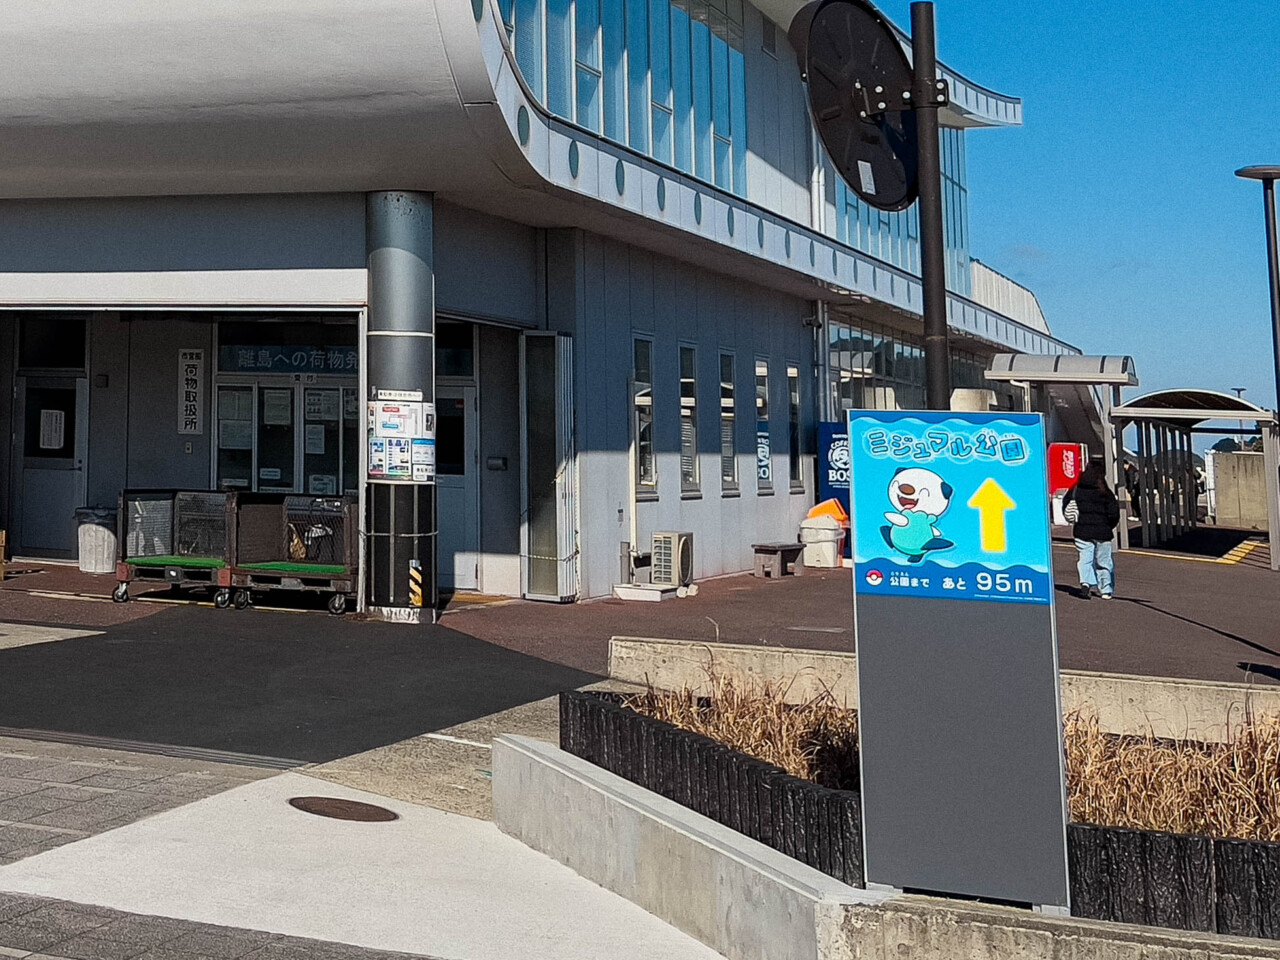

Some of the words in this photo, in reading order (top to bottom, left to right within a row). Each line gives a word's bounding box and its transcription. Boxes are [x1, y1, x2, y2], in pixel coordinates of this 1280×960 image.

[183, 363, 198, 431] 荷物取扱所
[869, 430, 1026, 462] ミジュマル公園
[890, 576, 930, 588] 公園まで
[942, 577, 968, 590] あと
